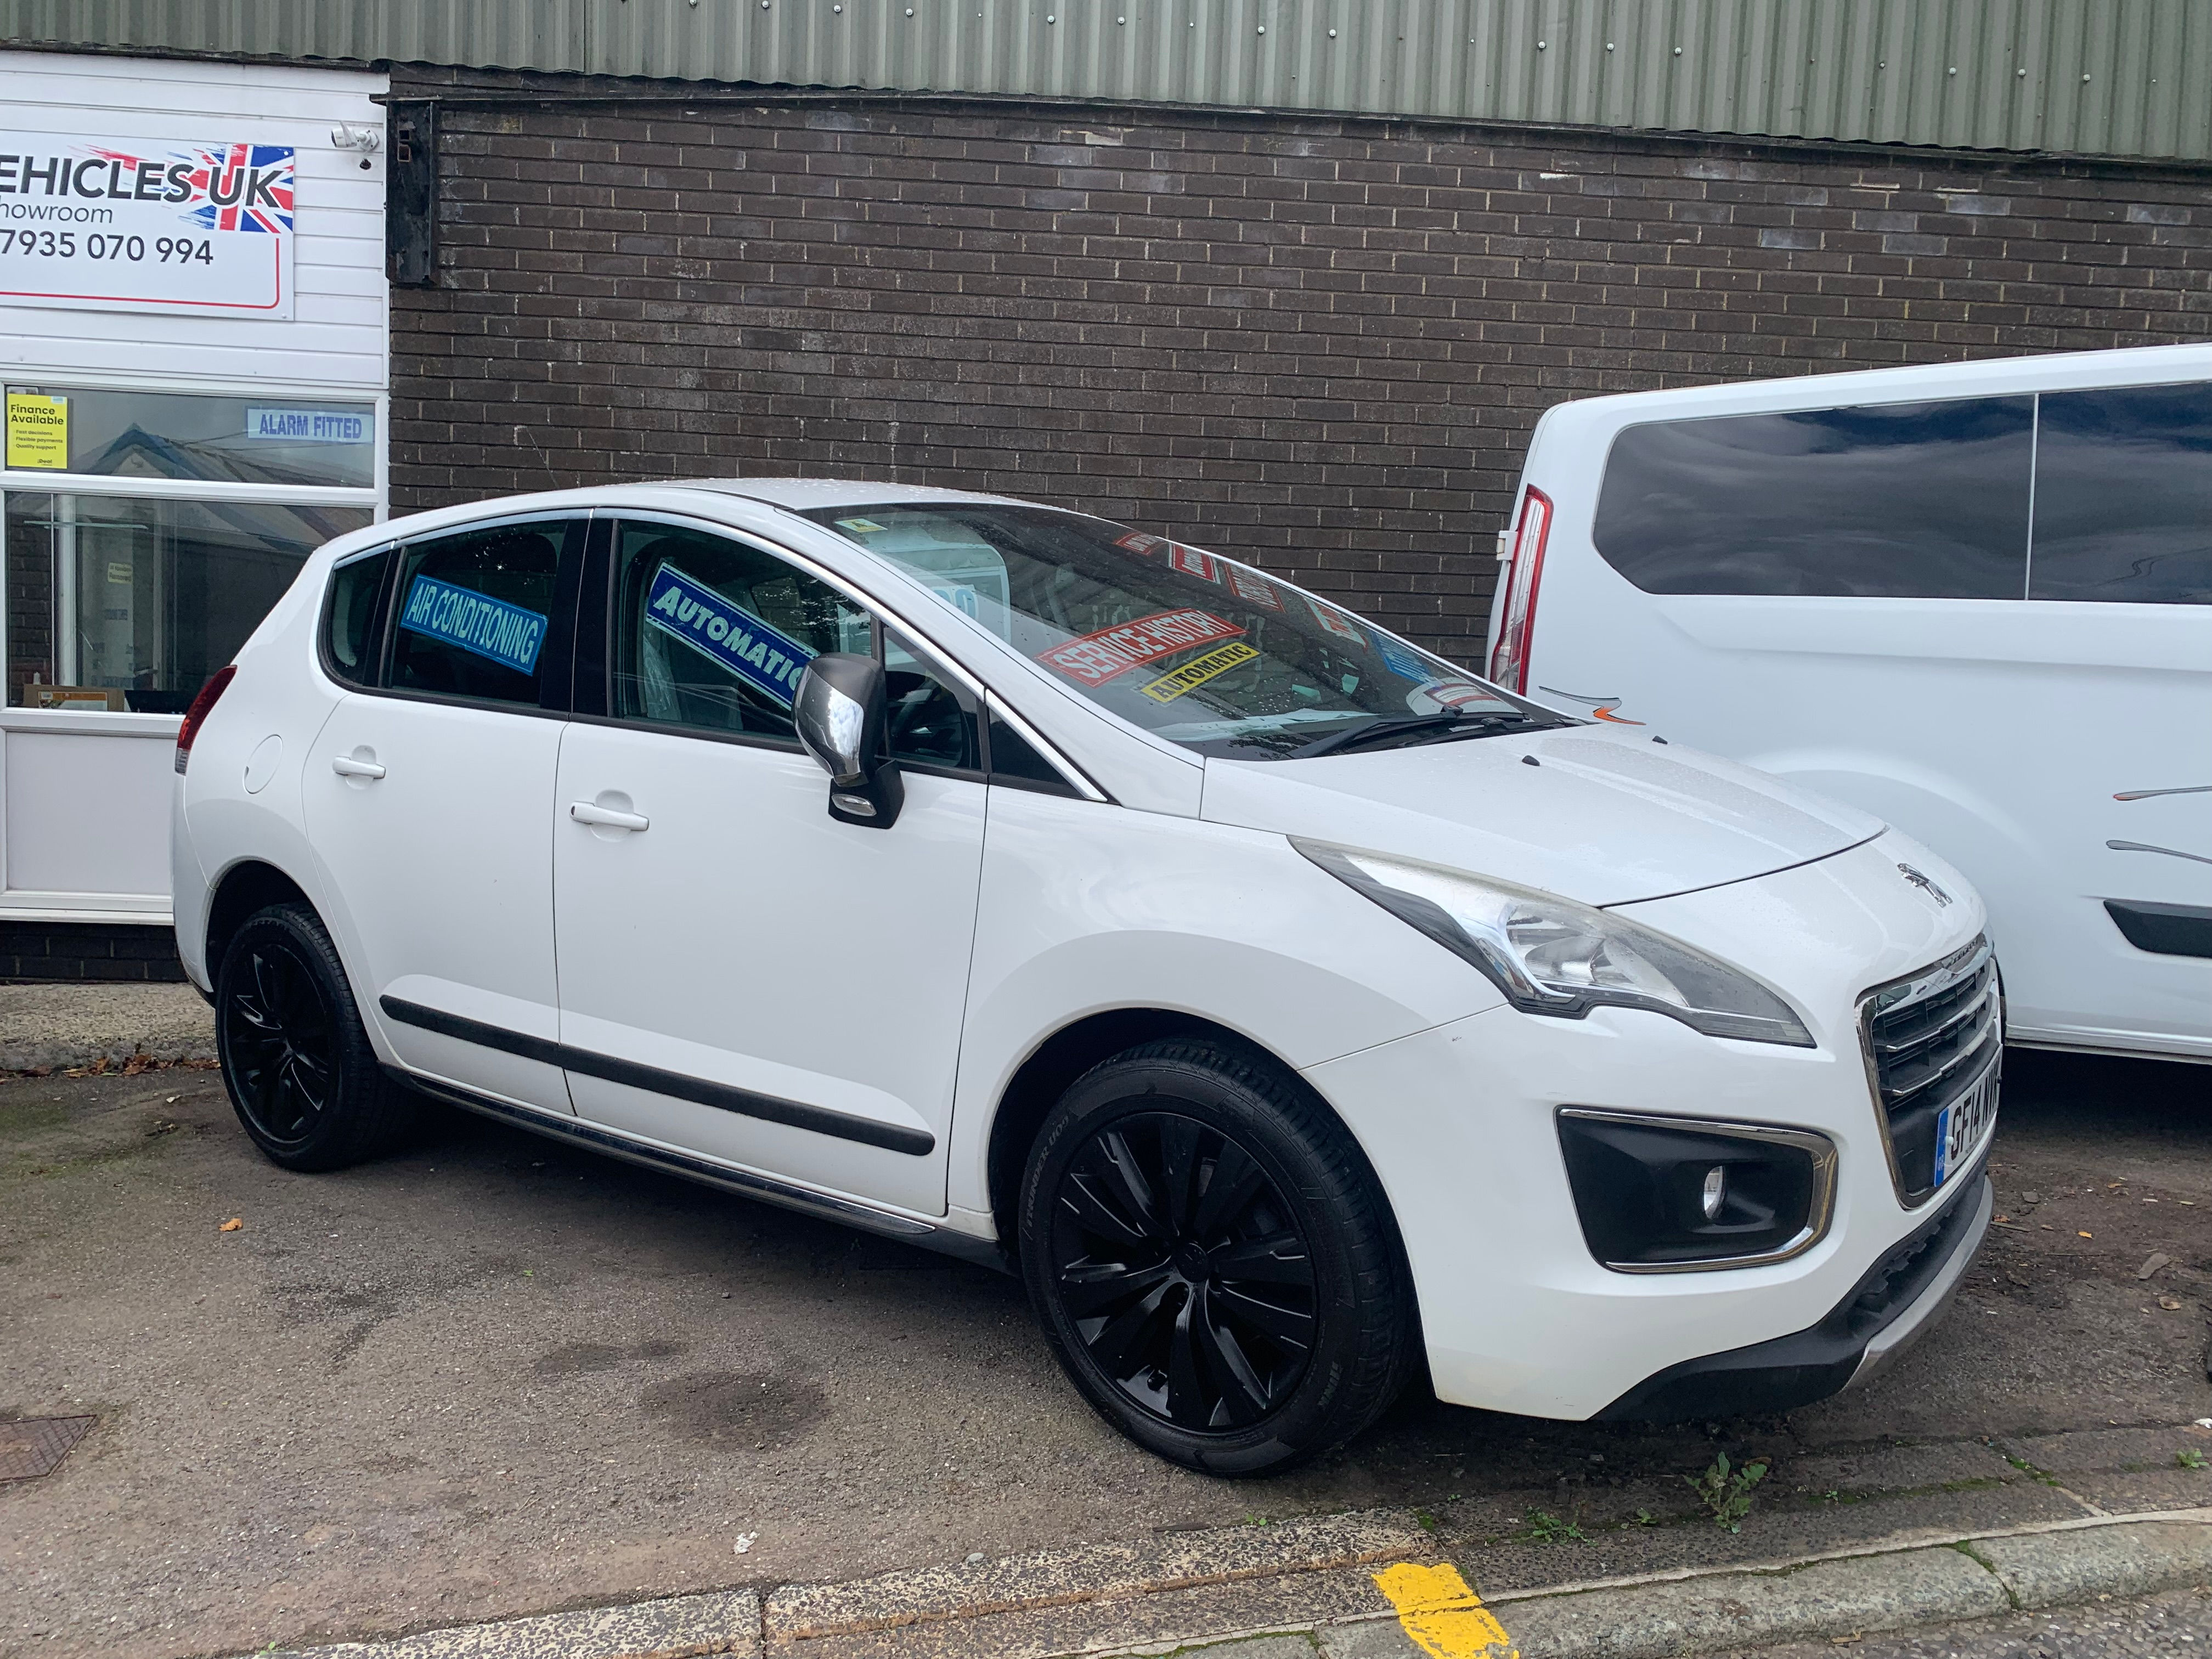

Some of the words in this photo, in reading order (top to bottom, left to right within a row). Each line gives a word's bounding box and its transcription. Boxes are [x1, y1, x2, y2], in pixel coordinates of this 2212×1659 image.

[0, 195, 113, 224] howroom
[0, 228, 75, 258] 7935
[87, 233, 144, 262] 070
[156, 237, 213, 266] 994
[10, 403, 55, 415] Finance
[10, 414, 64, 425] Available
[259, 414, 308, 436] ALARM
[313, 415, 362, 439] FITTED
[407, 583, 438, 625] AIR
[431, 589, 539, 664] CONDITIONING
[1052, 628, 1167, 680] SERVICE
[1133, 610, 1233, 647] HISTORY
[1151, 644, 1252, 699] AUTOMATIC
[1951, 1084, 1982, 1161] GF14
